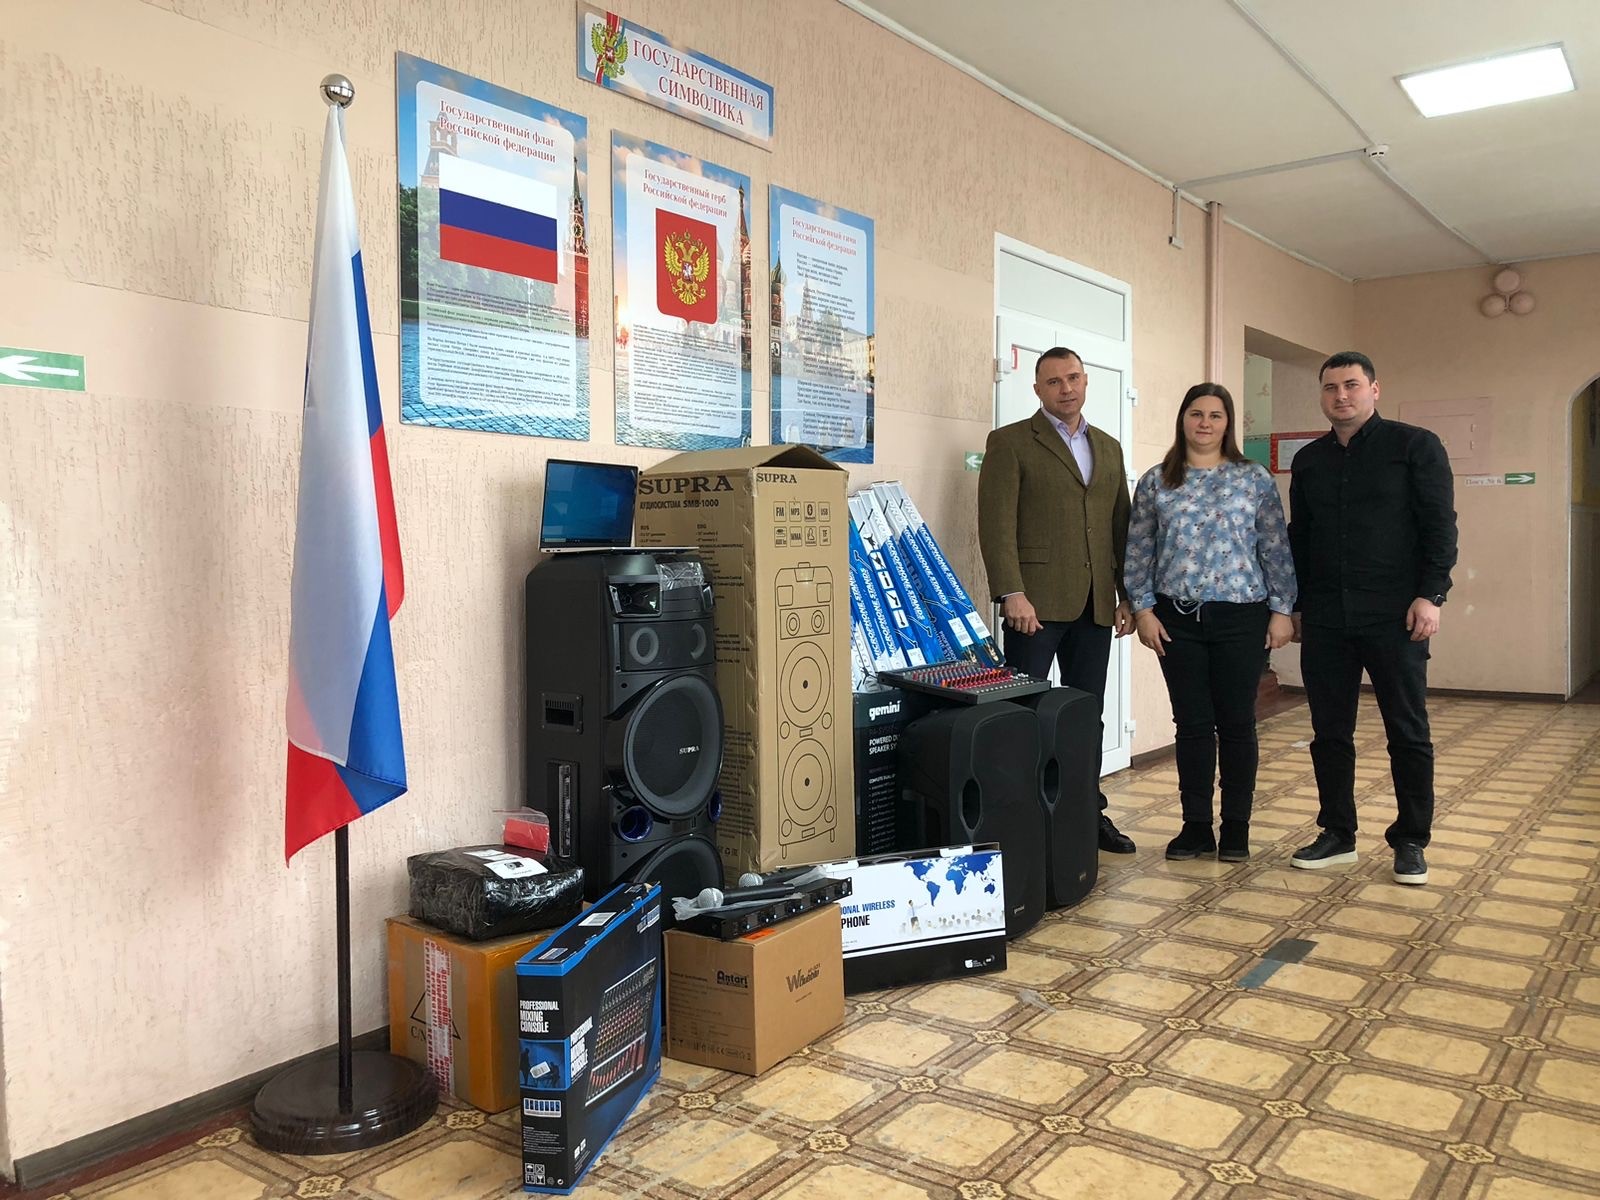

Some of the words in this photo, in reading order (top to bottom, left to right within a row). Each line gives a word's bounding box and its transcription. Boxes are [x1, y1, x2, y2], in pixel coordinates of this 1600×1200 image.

[633, 40, 763, 110] ГОСУДАРСТВЕННАЯ
[659, 76, 744, 125] СИМВОЛИКА
[440, 100, 530, 139] Государственный
[532, 131, 555, 147] флаг
[440, 117, 500, 145] Российской
[502, 137, 556, 163] федерации
[644, 169, 710, 198] Государственный
[711, 194, 726, 204] герб
[643, 183, 687, 204] Российской
[689, 198, 727, 218] федерации
[638, 475, 734, 495] SUPRA
[756, 472, 797, 483] SUPRA
[683, 499, 719, 508] SMB-1000
[776, 507, 784, 517] FM
[791, 508, 800, 516] MP3
[903, 527, 933, 577] MICROPHONE
[930, 576, 950, 605] STANDS
[919, 525, 951, 573] MICROPHONE
[946, 571, 966, 601] STANDS
[886, 537, 912, 591] MICROPHONE
[908, 589, 926, 620] STANDS
[869, 700, 901, 721] gemini
[679, 745, 700, 754] SUPRA
[841, 904, 860, 915] IONAL
[862, 900, 896, 912] WIRELESS
[841, 915, 870, 929] PHONE
[717, 970, 748, 987] Antari
[520, 1000, 560, 1011] PROFESSIONAL
[520, 1010, 544, 1022] MIXING
[520, 1021, 549, 1033] CONSOLE
